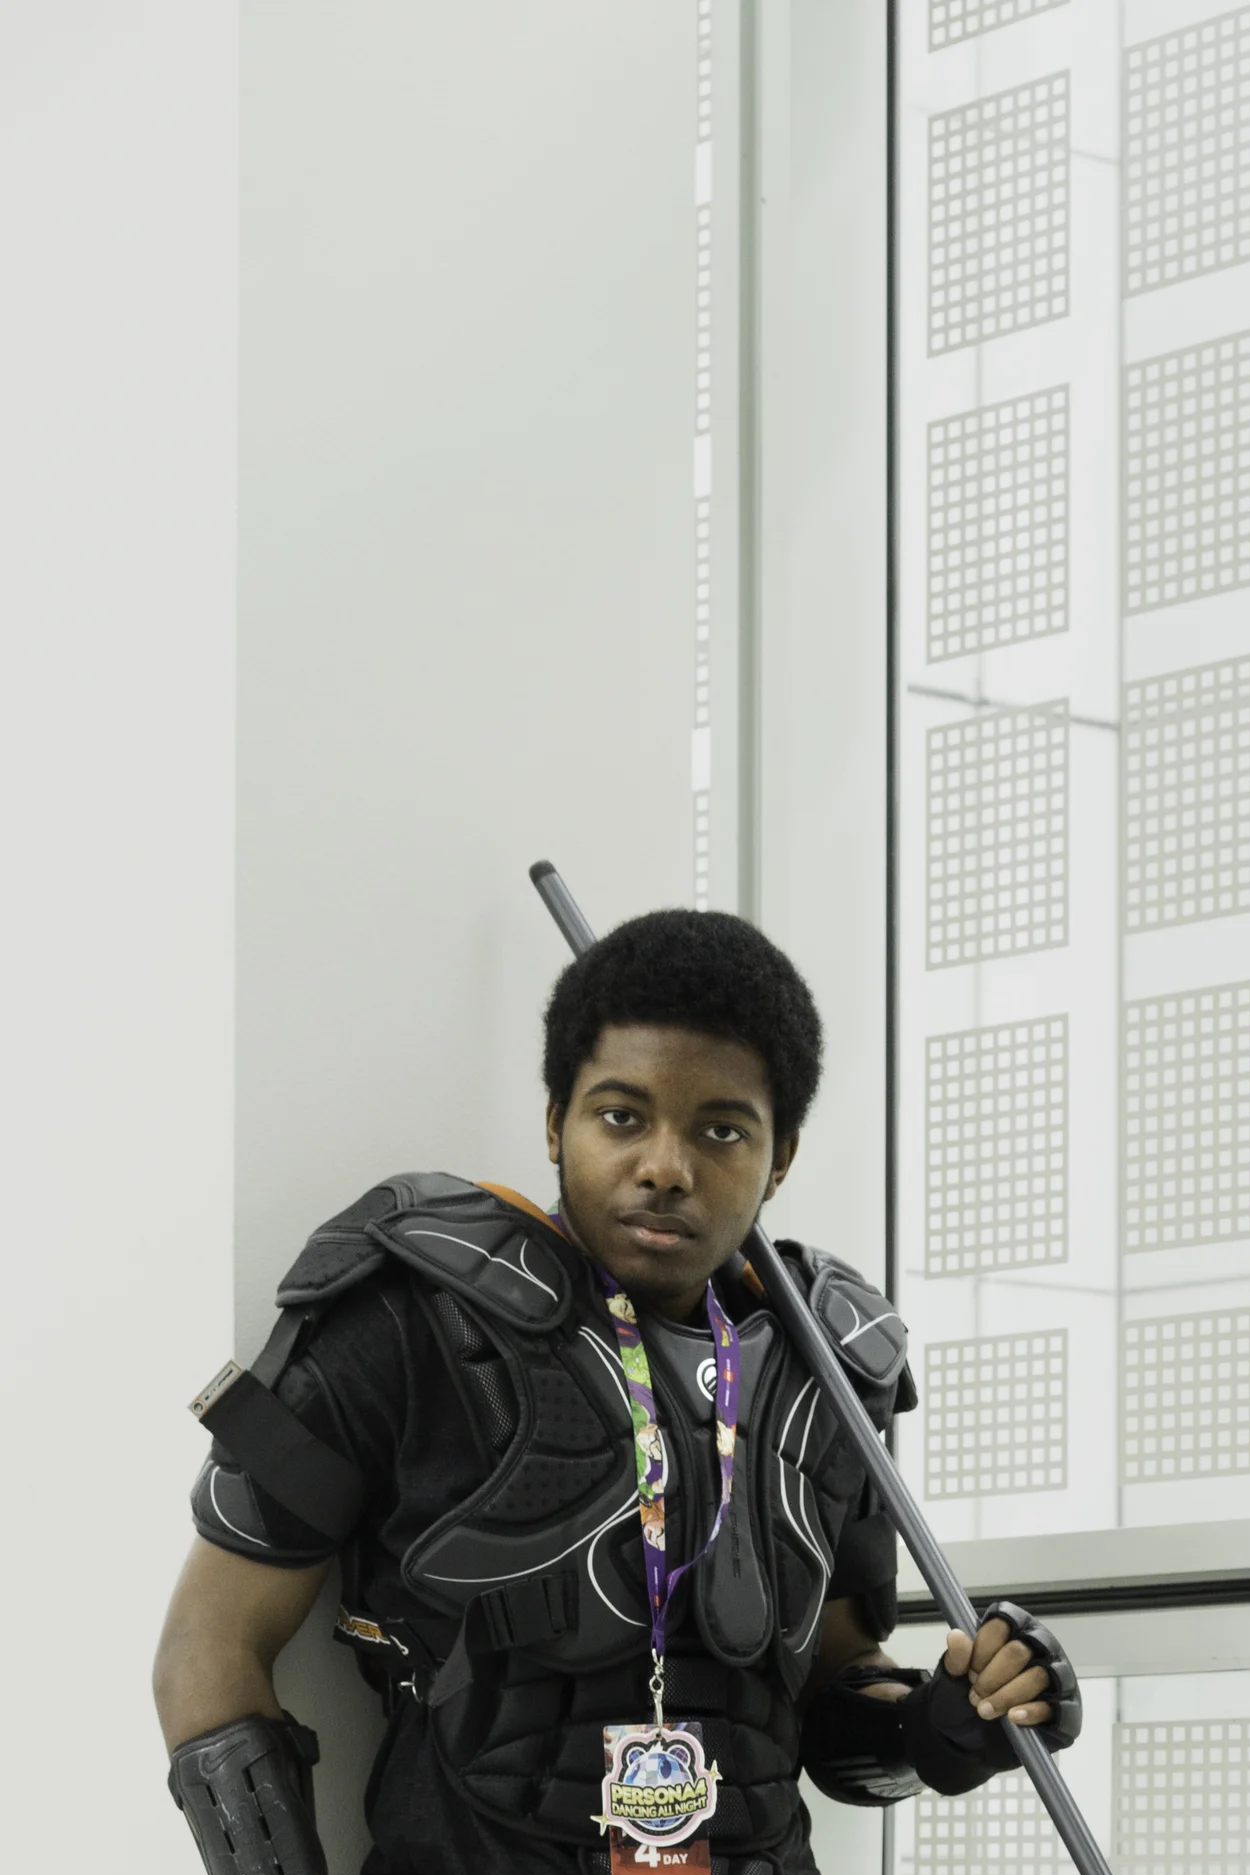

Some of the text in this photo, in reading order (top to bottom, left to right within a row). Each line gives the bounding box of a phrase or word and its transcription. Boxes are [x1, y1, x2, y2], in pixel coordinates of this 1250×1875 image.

[612, 1796, 707, 1818] DANCING ALL NIGHT
[634, 1843, 688, 1868] 4 DAY
